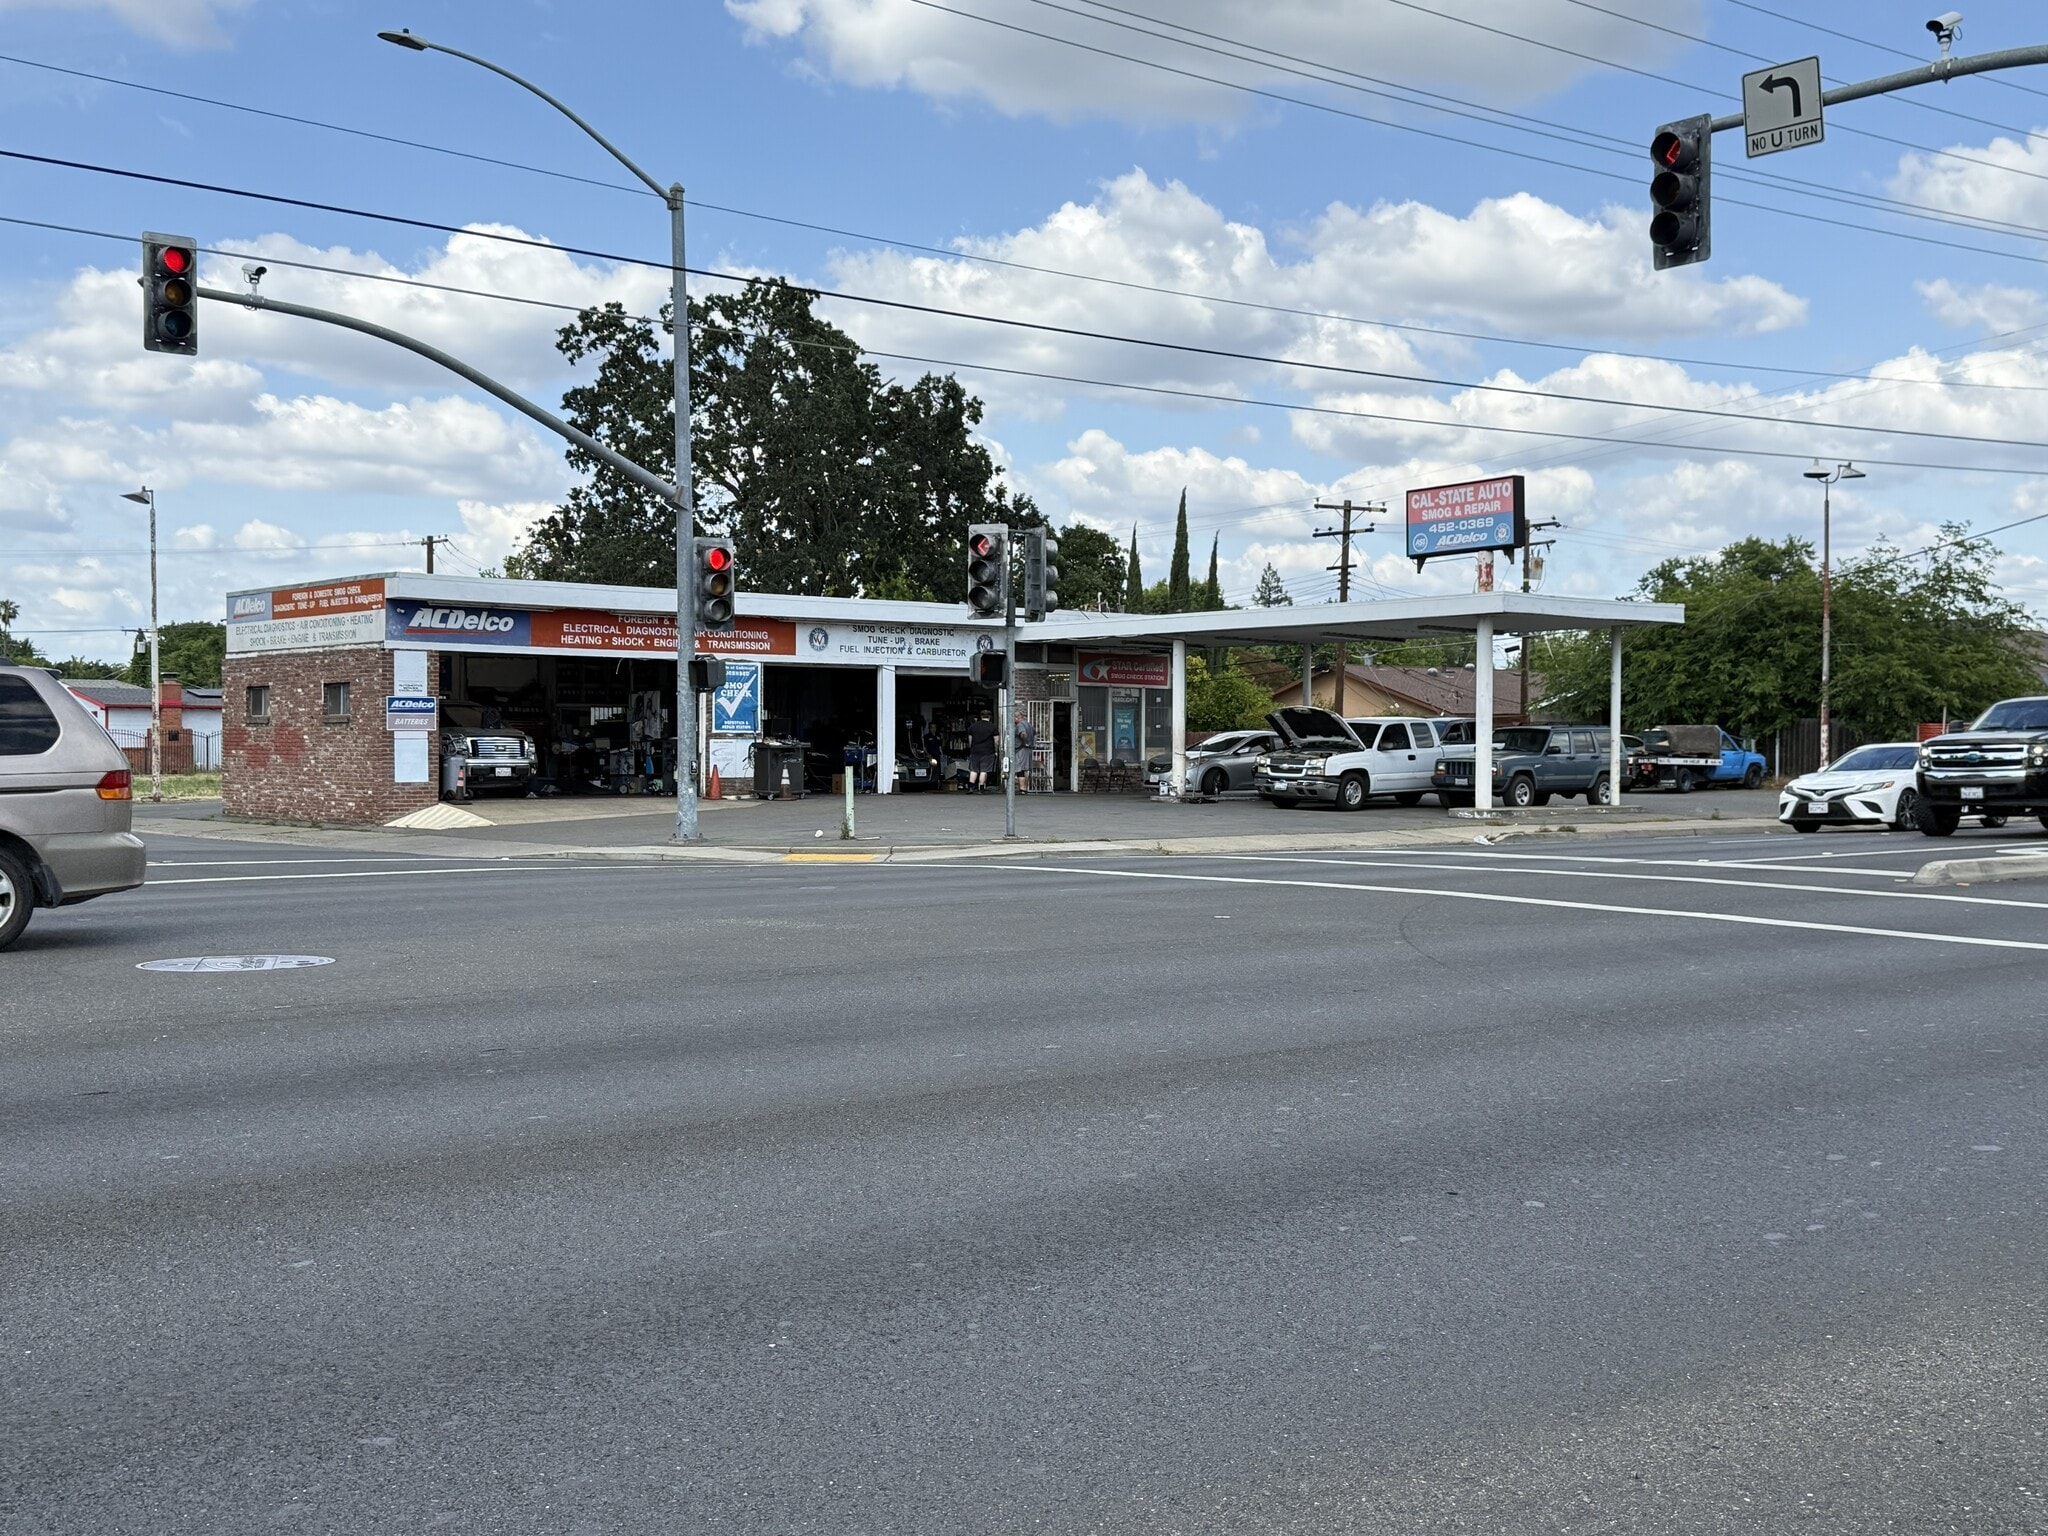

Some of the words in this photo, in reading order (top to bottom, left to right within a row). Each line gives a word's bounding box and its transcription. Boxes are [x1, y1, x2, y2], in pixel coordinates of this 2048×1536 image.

[1752, 136, 1766, 152] NO
[1771, 131, 1782, 148] U
[1787, 124, 1818, 143] TURN
[1411, 486, 1474, 510] CAL-STATE
[1478, 482, 1511, 500] AUTO
[1422, 508, 1452, 520] SMOG
[1454, 507, 1462, 516] &
[1464, 500, 1501, 515] REPAIR
[1437, 532, 1488, 546] ACDelco
[234, 598, 266, 614] ACDelco
[236, 626, 264, 636] ELECTRICAL
[300, 620, 309, 630] AIR
[309, 616, 346, 630] CONDITIONING
[350, 614, 374, 625] HEATING
[408, 607, 514, 632] ACDelco
[618, 616, 658, 624] FOREIGN
[664, 616, 670, 625] &
[250, 638, 266, 646] SHOCK
[270, 635, 287, 646] BRAKE
[290, 633, 309, 644] ENGINE
[318, 629, 357, 641] TRANSMISSION
[563, 624, 622, 634] ELECTRICAL
[708, 630, 768, 640] CONDITIONING
[852, 625, 876, 633] SMOG
[880, 626, 906, 634] CHECK
[910, 628, 955, 636] DIAGNOSTIC
[560, 635, 602, 645] HEATING
[612, 637, 645, 646] SHOCK
[654, 638, 678, 648] ENGI
[694, 640, 701, 648] &
[707, 640, 770, 650] TRANSMISSION
[914, 638, 940, 646] BRAKE
[840, 645, 860, 654] FUEL
[864, 646, 903, 655] INJECTION
[907, 647, 913, 655] &
[916, 648, 966, 657] CARBURETOR
[1112, 661, 1132, 670] STAR
[1134, 662, 1164, 672] Certified
[720, 690, 752, 698] CHEK
[390, 700, 434, 708] ACDelco
